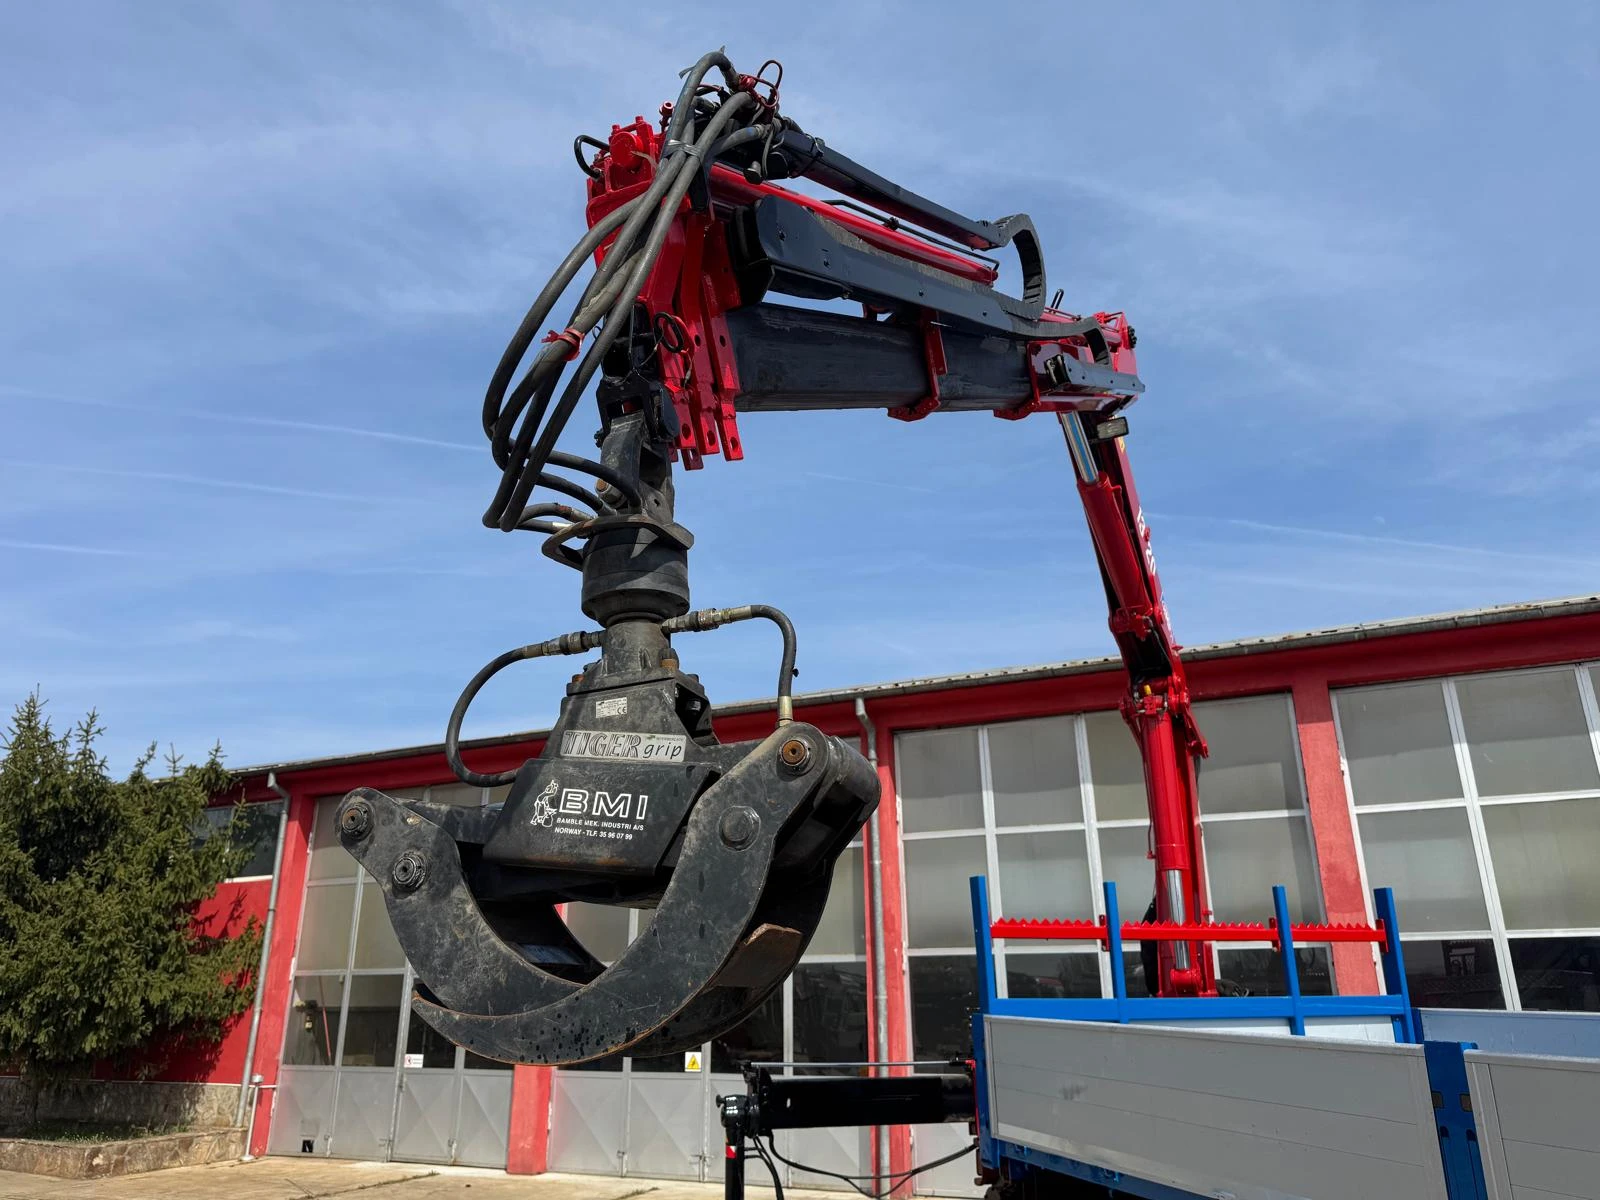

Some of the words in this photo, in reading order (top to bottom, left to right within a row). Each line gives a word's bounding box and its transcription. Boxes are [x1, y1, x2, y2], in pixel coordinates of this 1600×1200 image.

[564, 731, 642, 758] TIGER
[643, 741, 682, 760] grip
[559, 788, 648, 820] BMI
[554, 826, 582, 836] NORWAY
[556, 817, 583, 826] BAMBLE
[601, 821, 632, 830] INDUSTRI
